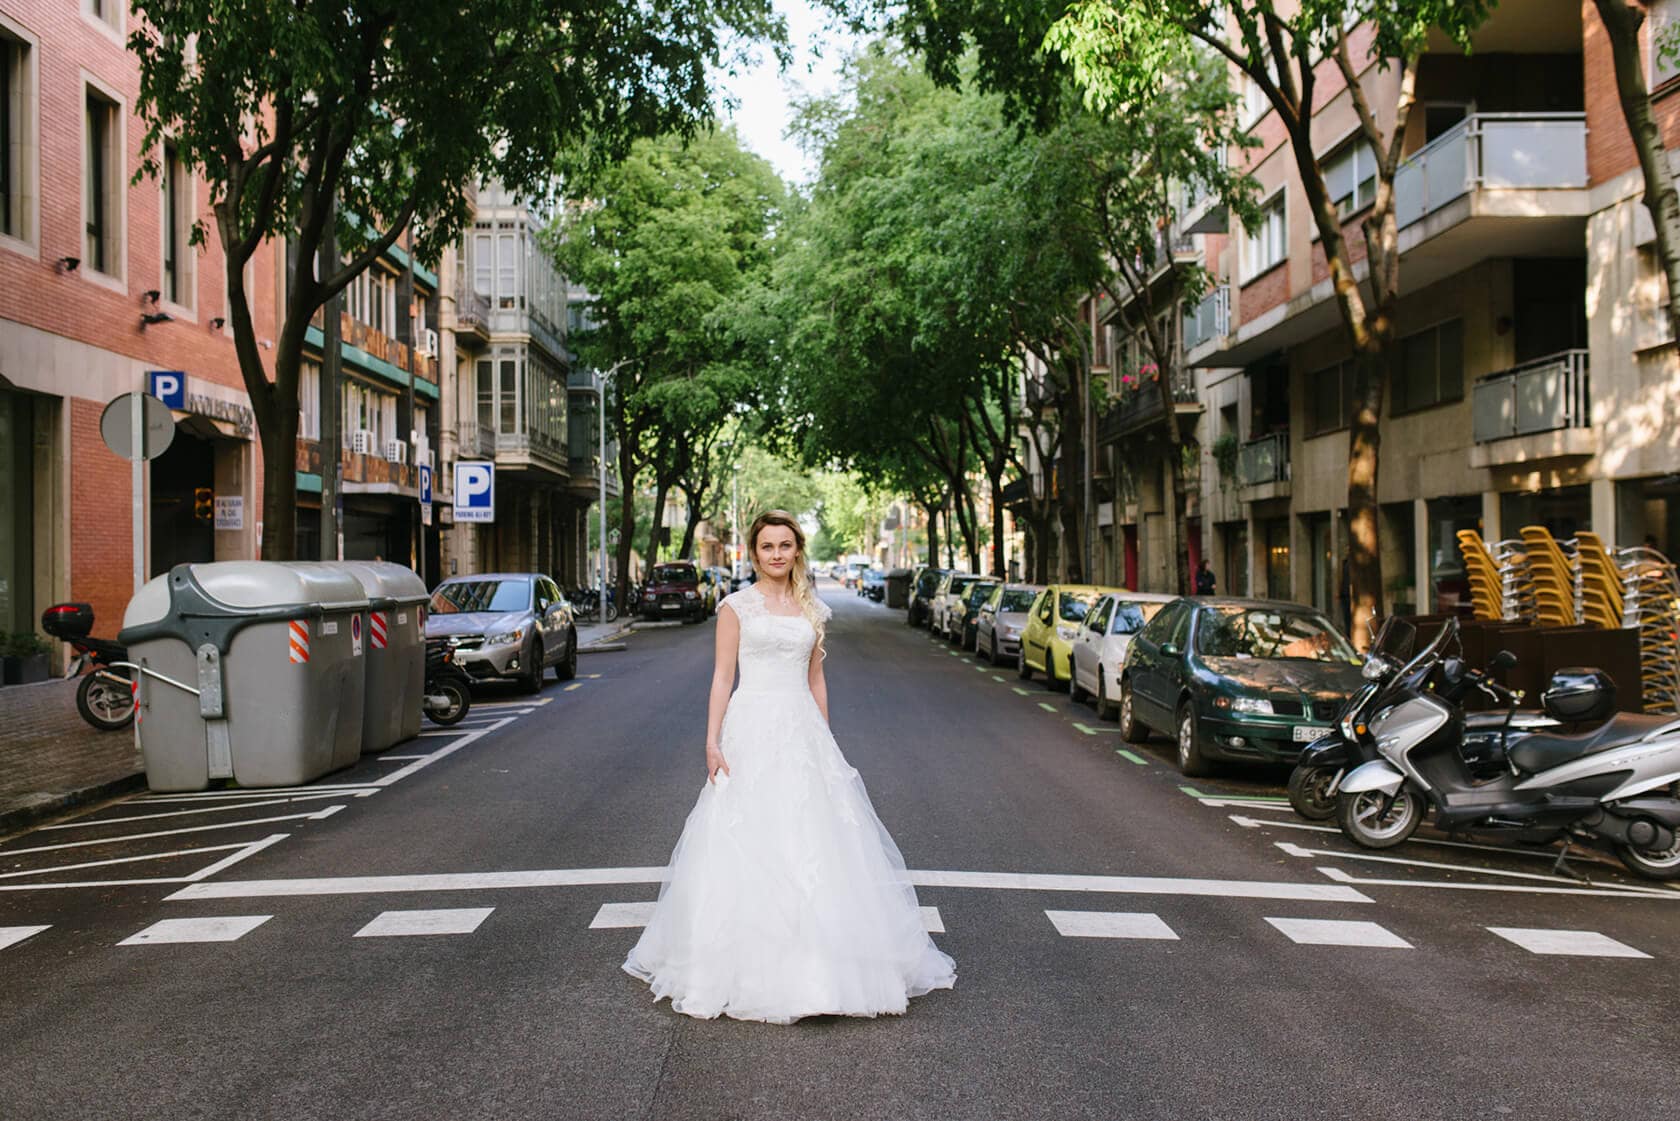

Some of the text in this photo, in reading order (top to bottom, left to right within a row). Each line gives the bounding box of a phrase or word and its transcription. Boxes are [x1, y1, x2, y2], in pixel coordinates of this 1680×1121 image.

[156, 376, 179, 402] P
[422, 469, 430, 500] P
[457, 466, 490, 507] P
